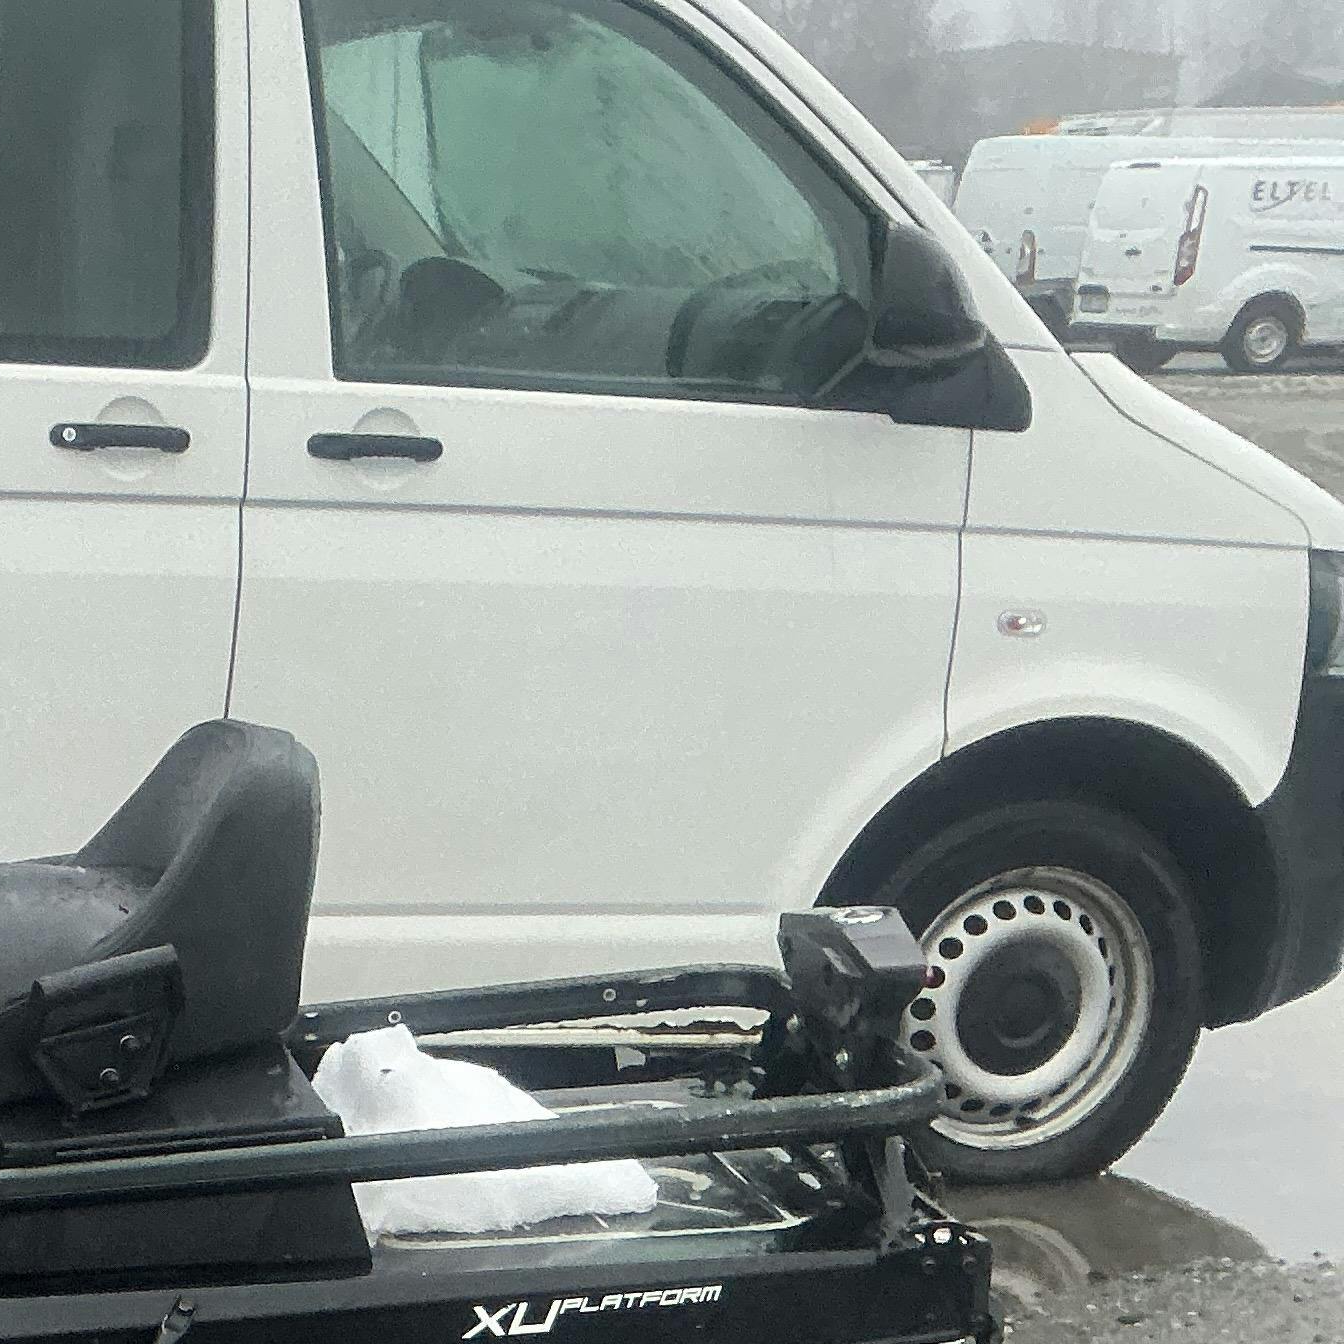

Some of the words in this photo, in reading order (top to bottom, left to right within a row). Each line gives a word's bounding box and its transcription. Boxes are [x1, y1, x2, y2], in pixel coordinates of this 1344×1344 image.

[1252, 179, 1332, 202] ELTEL
[462, 1299, 562, 1339] XU
[559, 1285, 722, 1315] PLATFORM
